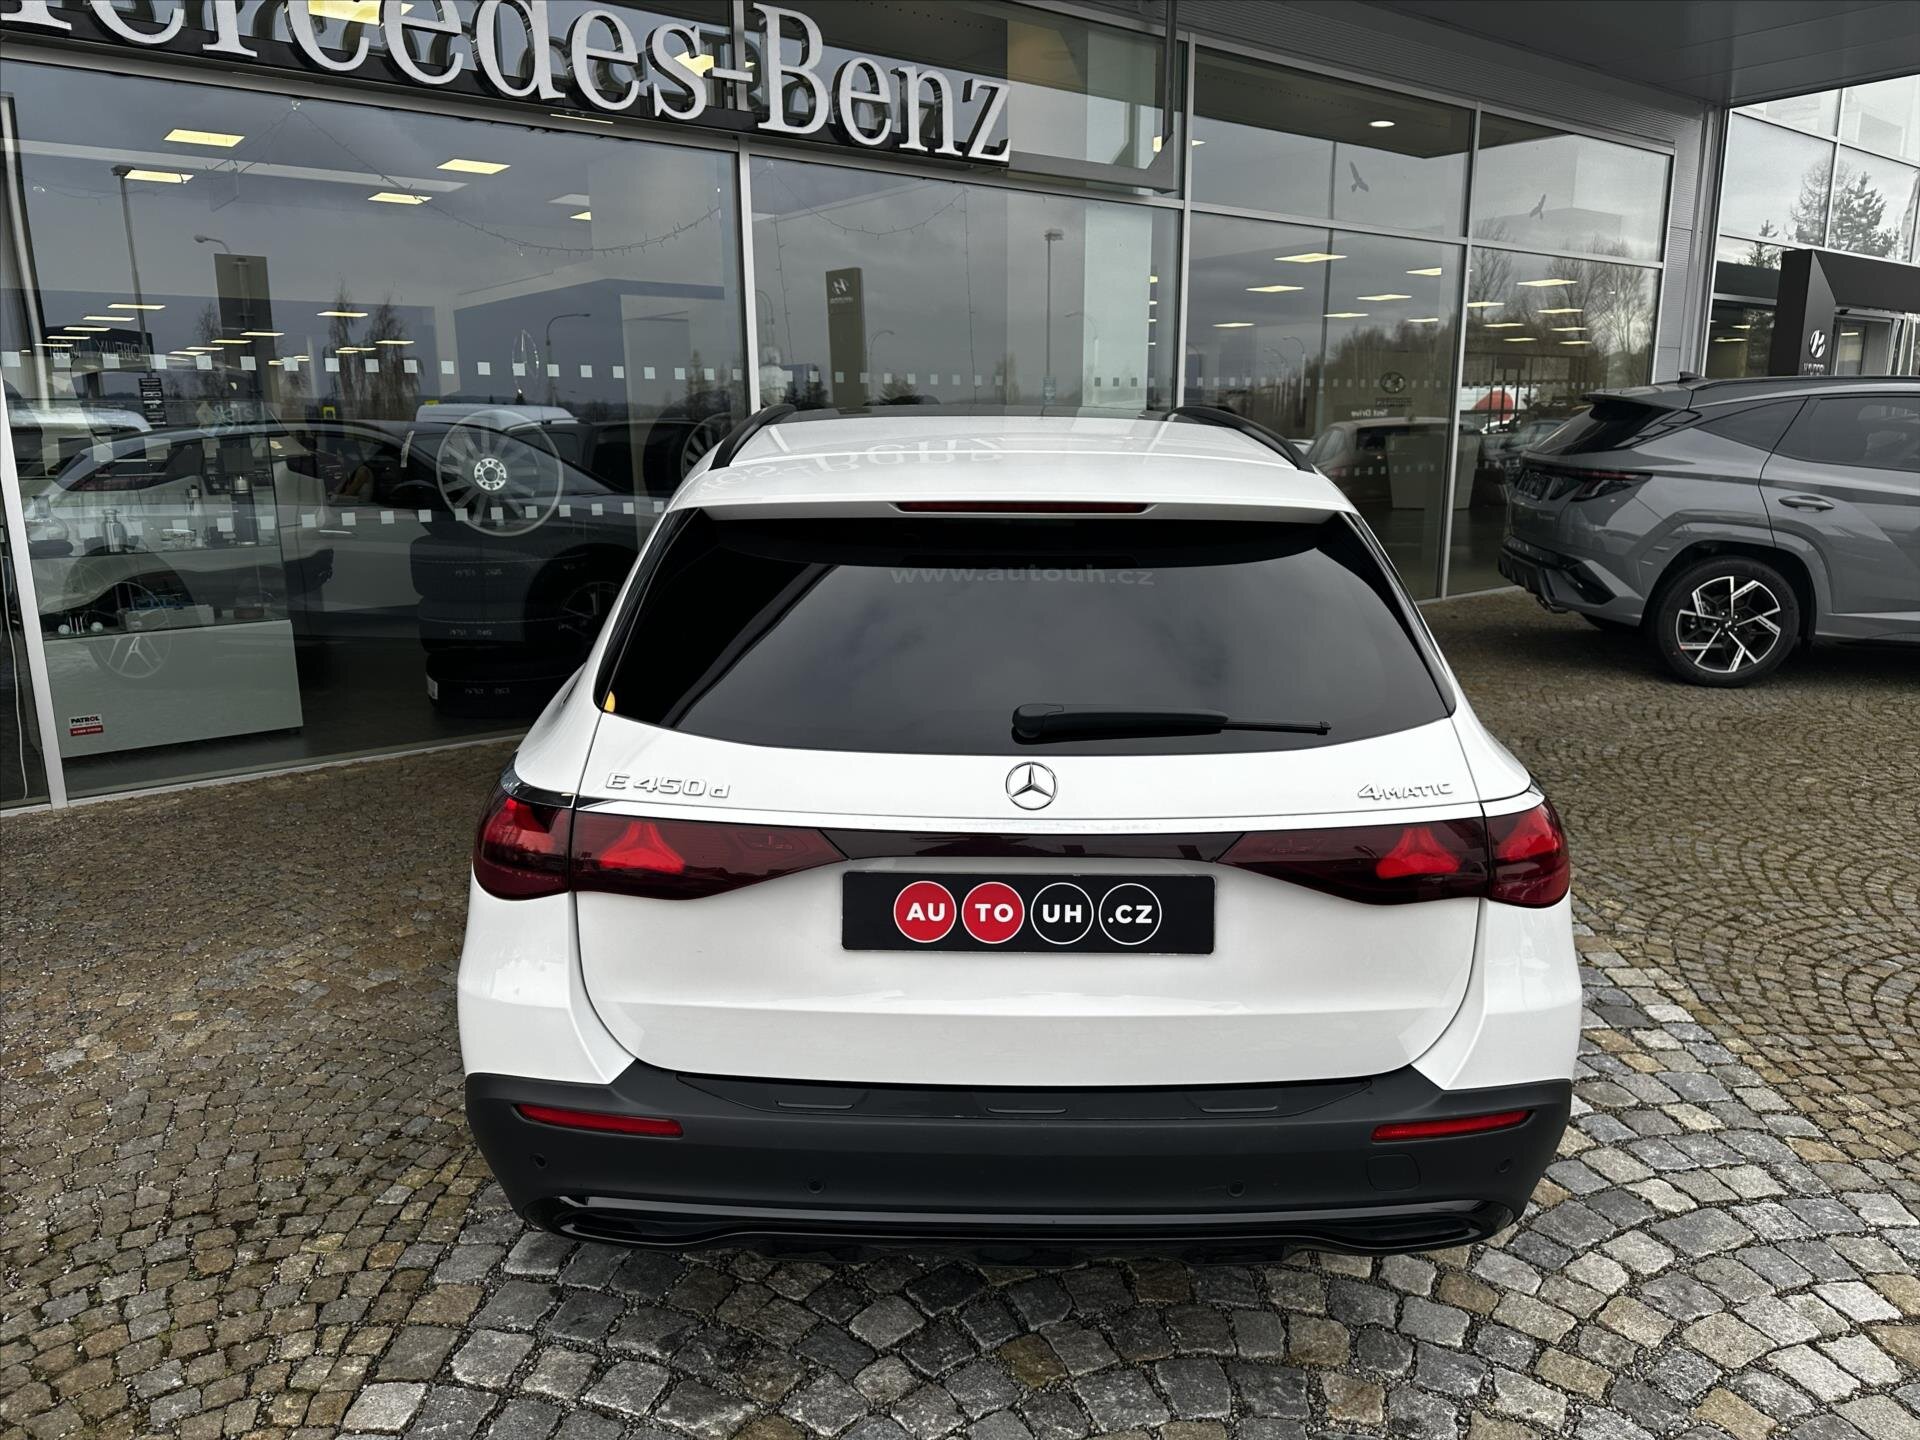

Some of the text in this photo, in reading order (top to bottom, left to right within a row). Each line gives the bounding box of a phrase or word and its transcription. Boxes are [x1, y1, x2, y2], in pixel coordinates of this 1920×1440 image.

[0, 0, 1011, 162] rcedes-Benz
[890, 565, 1155, 586] www.autouh.cz
[71, 716, 100, 724] PATROL
[606, 772, 630, 790] E
[1358, 783, 1453, 800] 4MATIC
